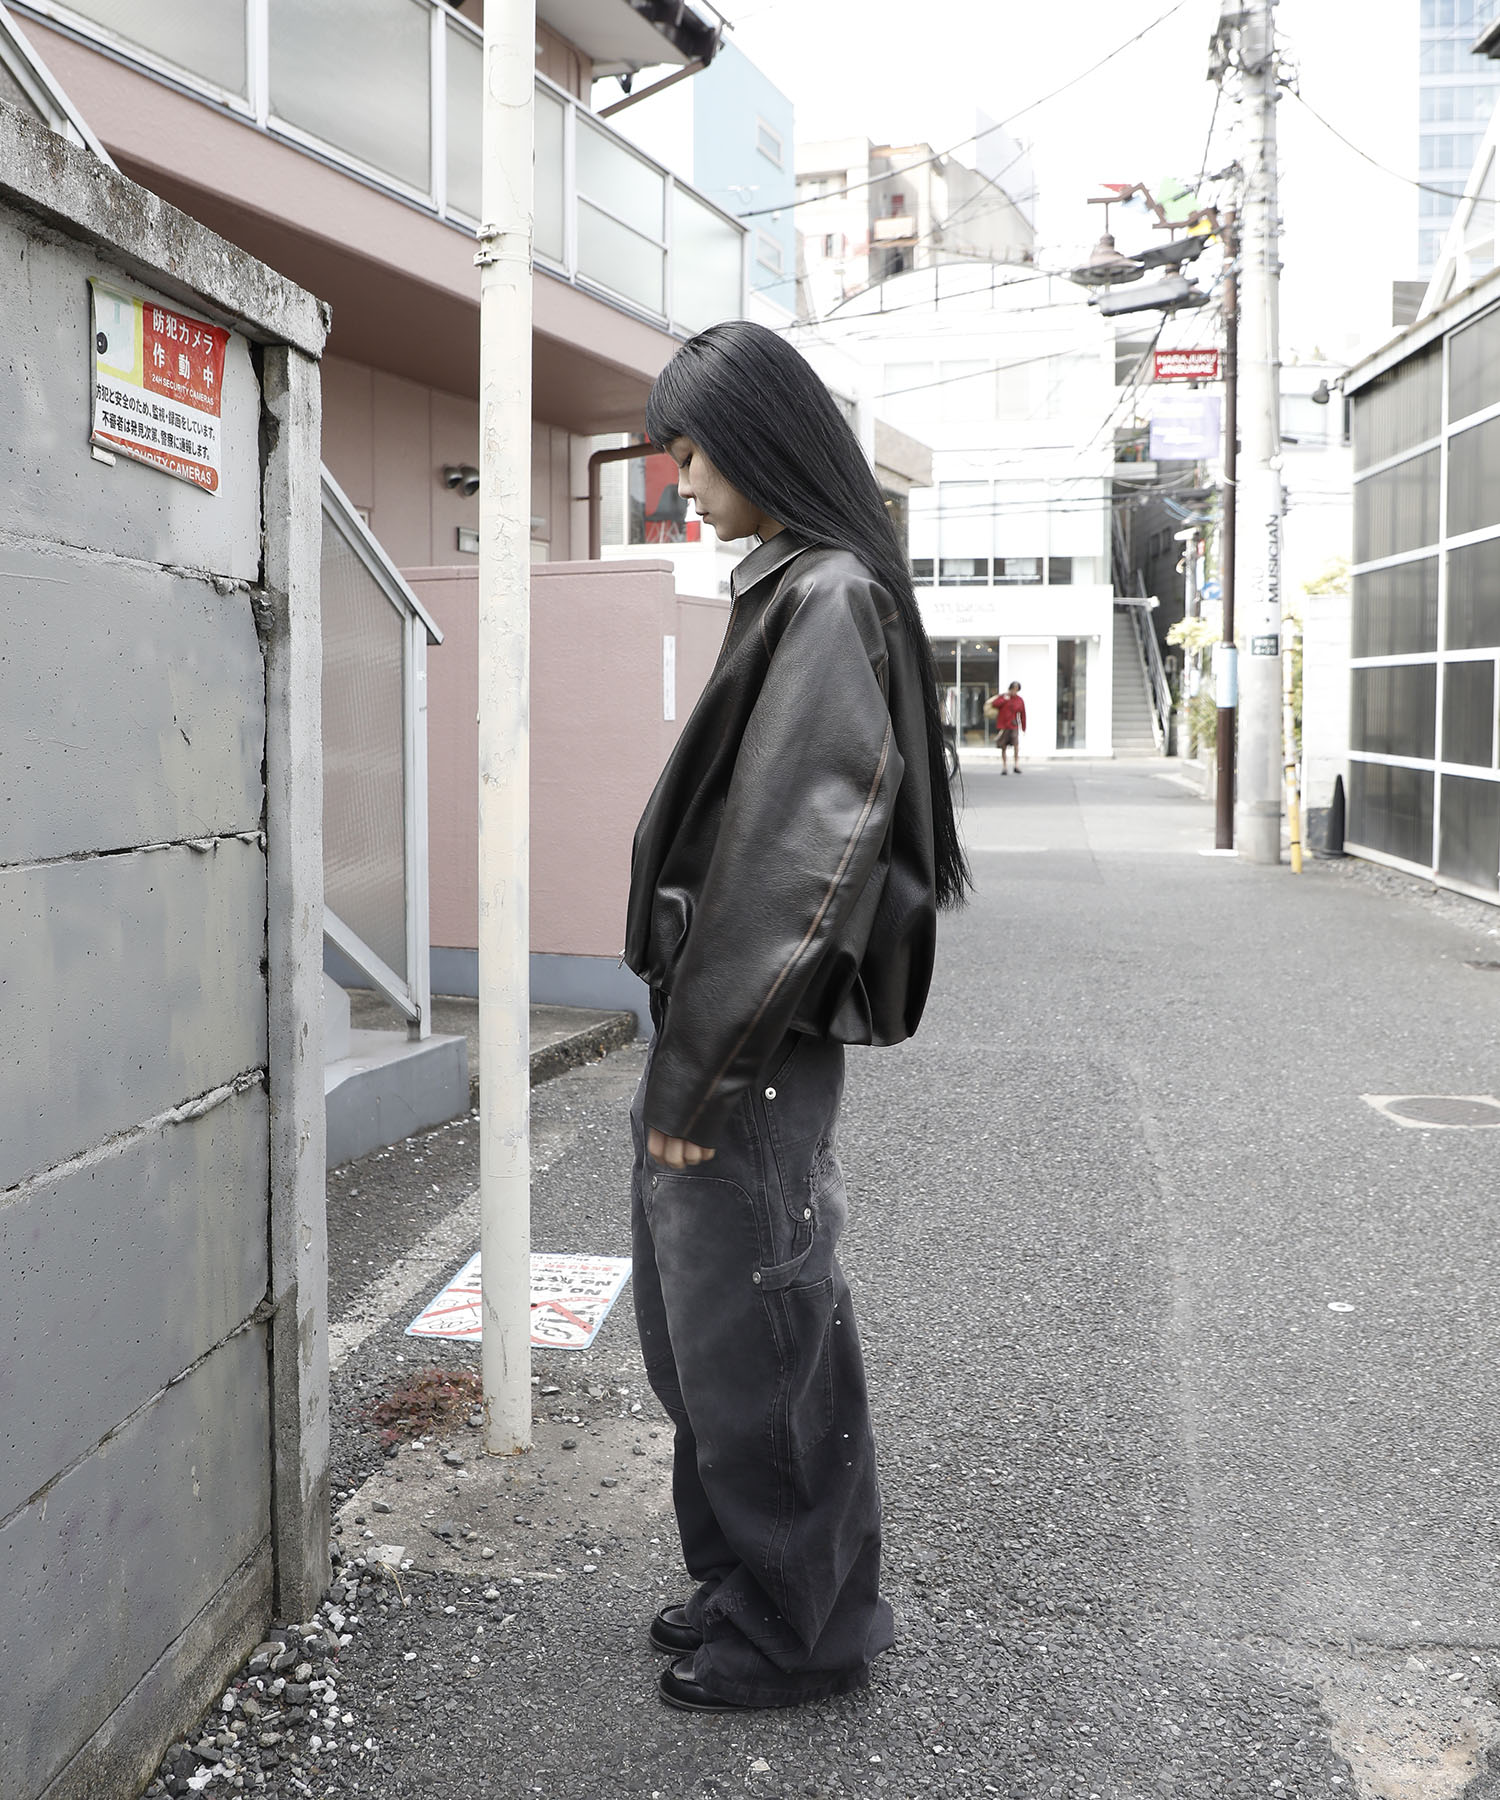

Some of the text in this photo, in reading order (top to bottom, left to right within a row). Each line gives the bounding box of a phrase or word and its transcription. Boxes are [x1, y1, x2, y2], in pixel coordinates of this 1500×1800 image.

[152, 308, 213, 355] 防犯カメラ
[152, 373, 163, 385] 24H
[162, 377, 189, 397] SECURITY
[189, 389, 215, 406] CAMERAS
[169, 460, 212, 485] CAMERAS
[1267, 514, 1279, 603] MUSICIAN
